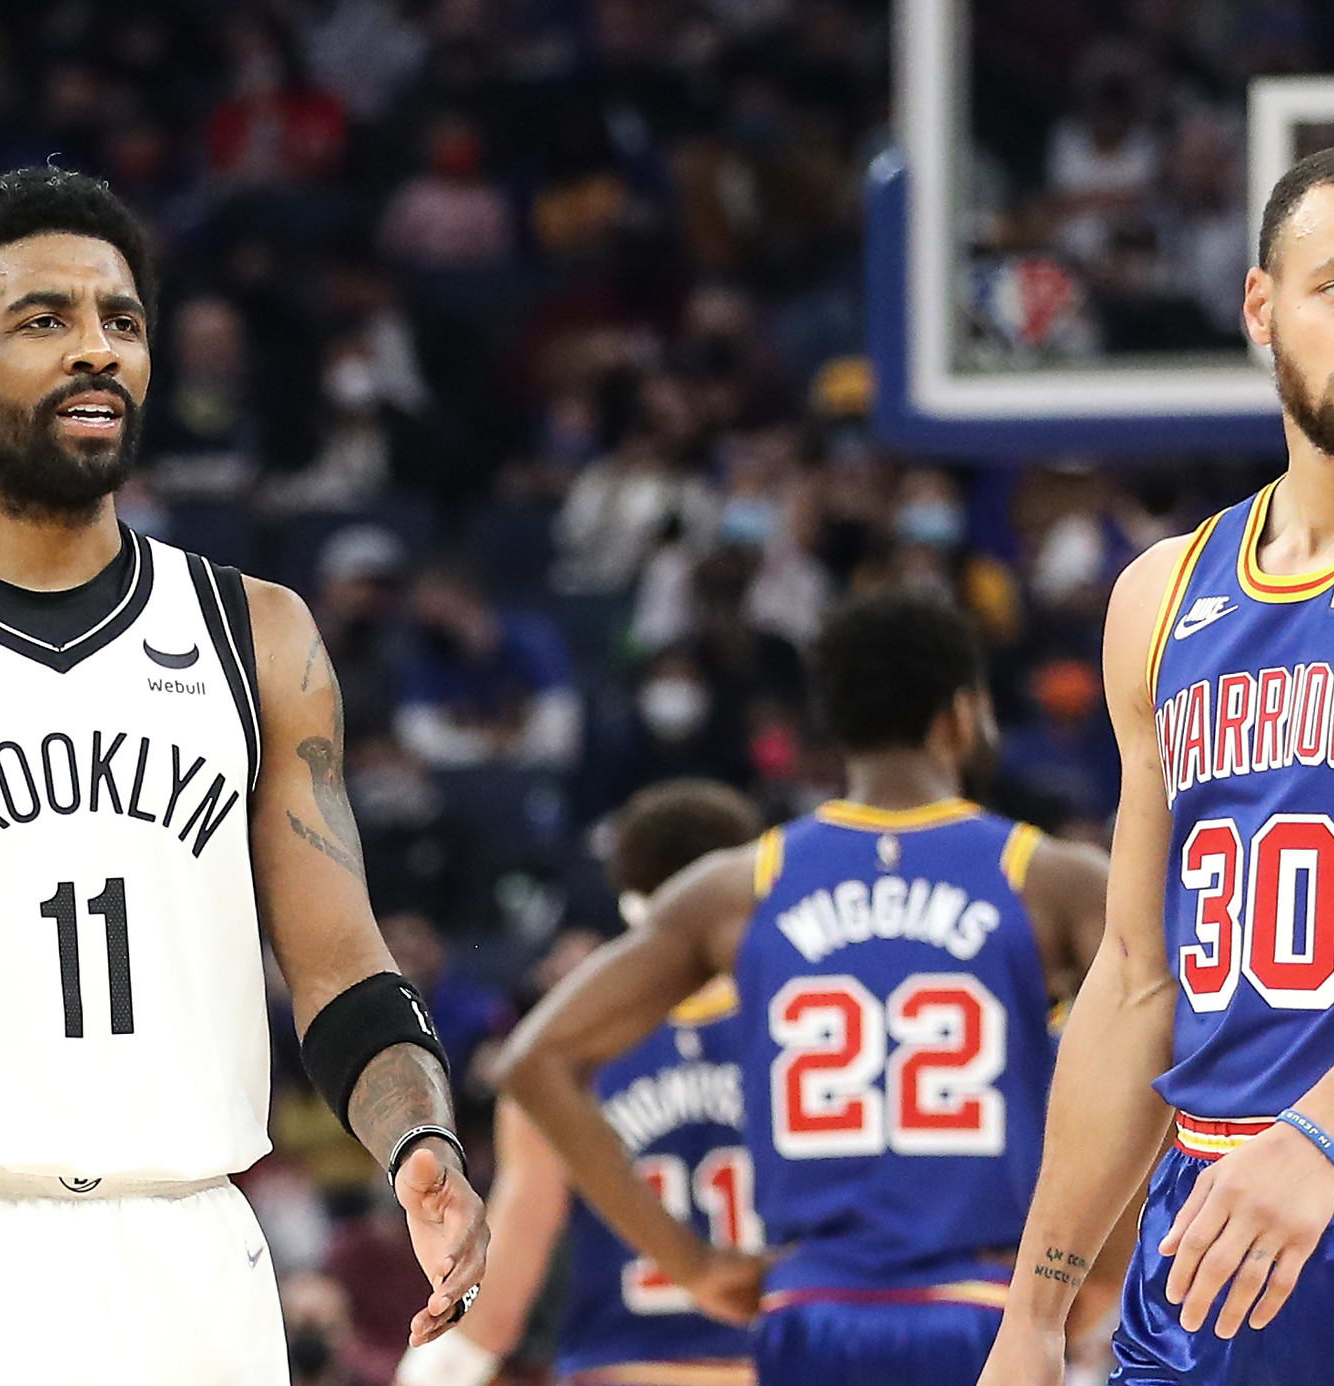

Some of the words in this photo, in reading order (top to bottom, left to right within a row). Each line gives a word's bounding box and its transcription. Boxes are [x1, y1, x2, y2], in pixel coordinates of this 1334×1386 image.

[1185, 597, 1230, 623] NIKE
[147, 678, 206, 695] Webull
[40, 877, 134, 1038] 11
[775, 876, 1001, 964] WIGGINS
[768, 972, 1008, 1160] 22
